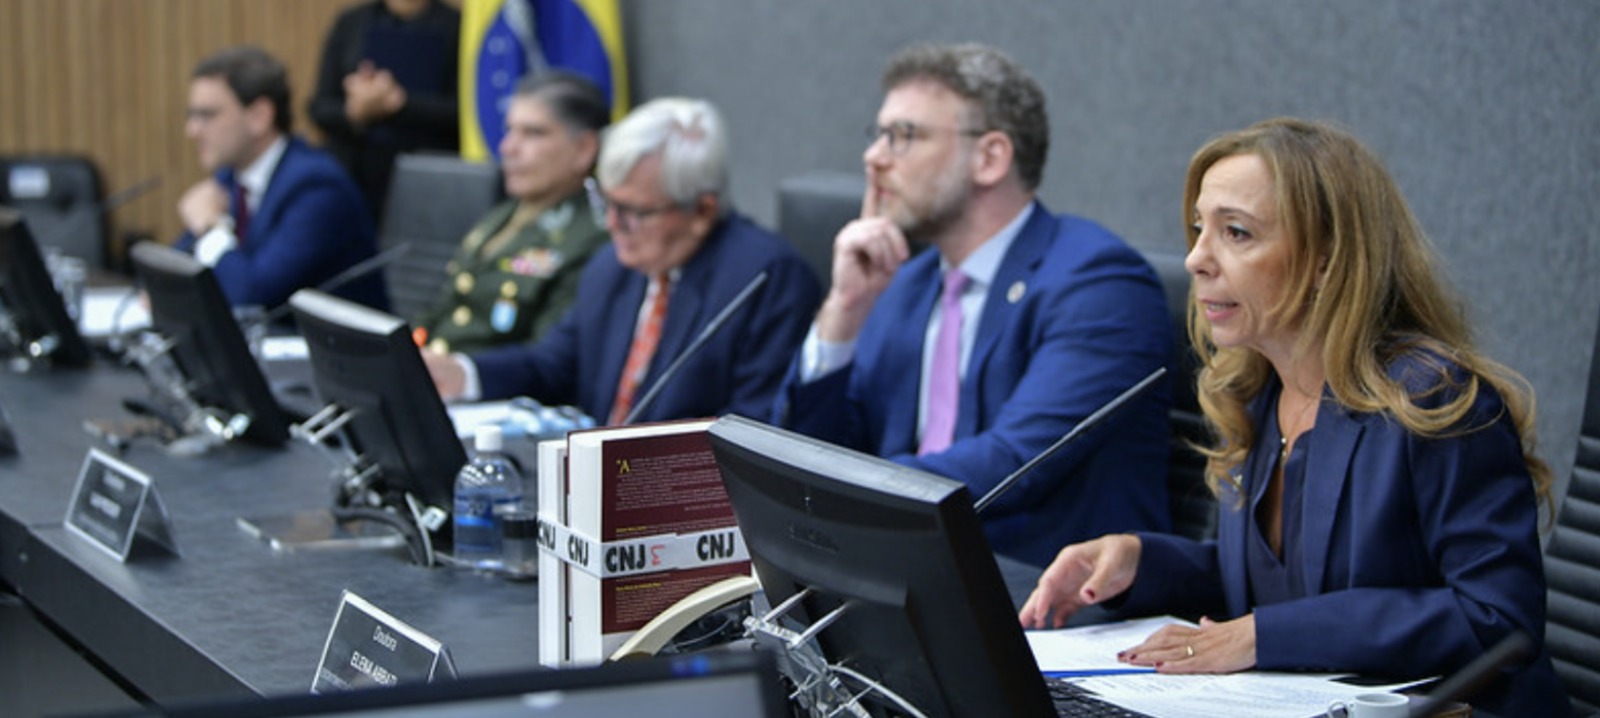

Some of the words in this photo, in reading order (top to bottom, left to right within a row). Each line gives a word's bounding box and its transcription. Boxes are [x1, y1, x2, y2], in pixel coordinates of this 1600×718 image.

[568, 534, 589, 567] CNJ
[605, 543, 646, 573] CNJ
[696, 532, 734, 561] CNJ
[373, 625, 397, 651] Doutora
[350, 650, 374, 674] ELENA
